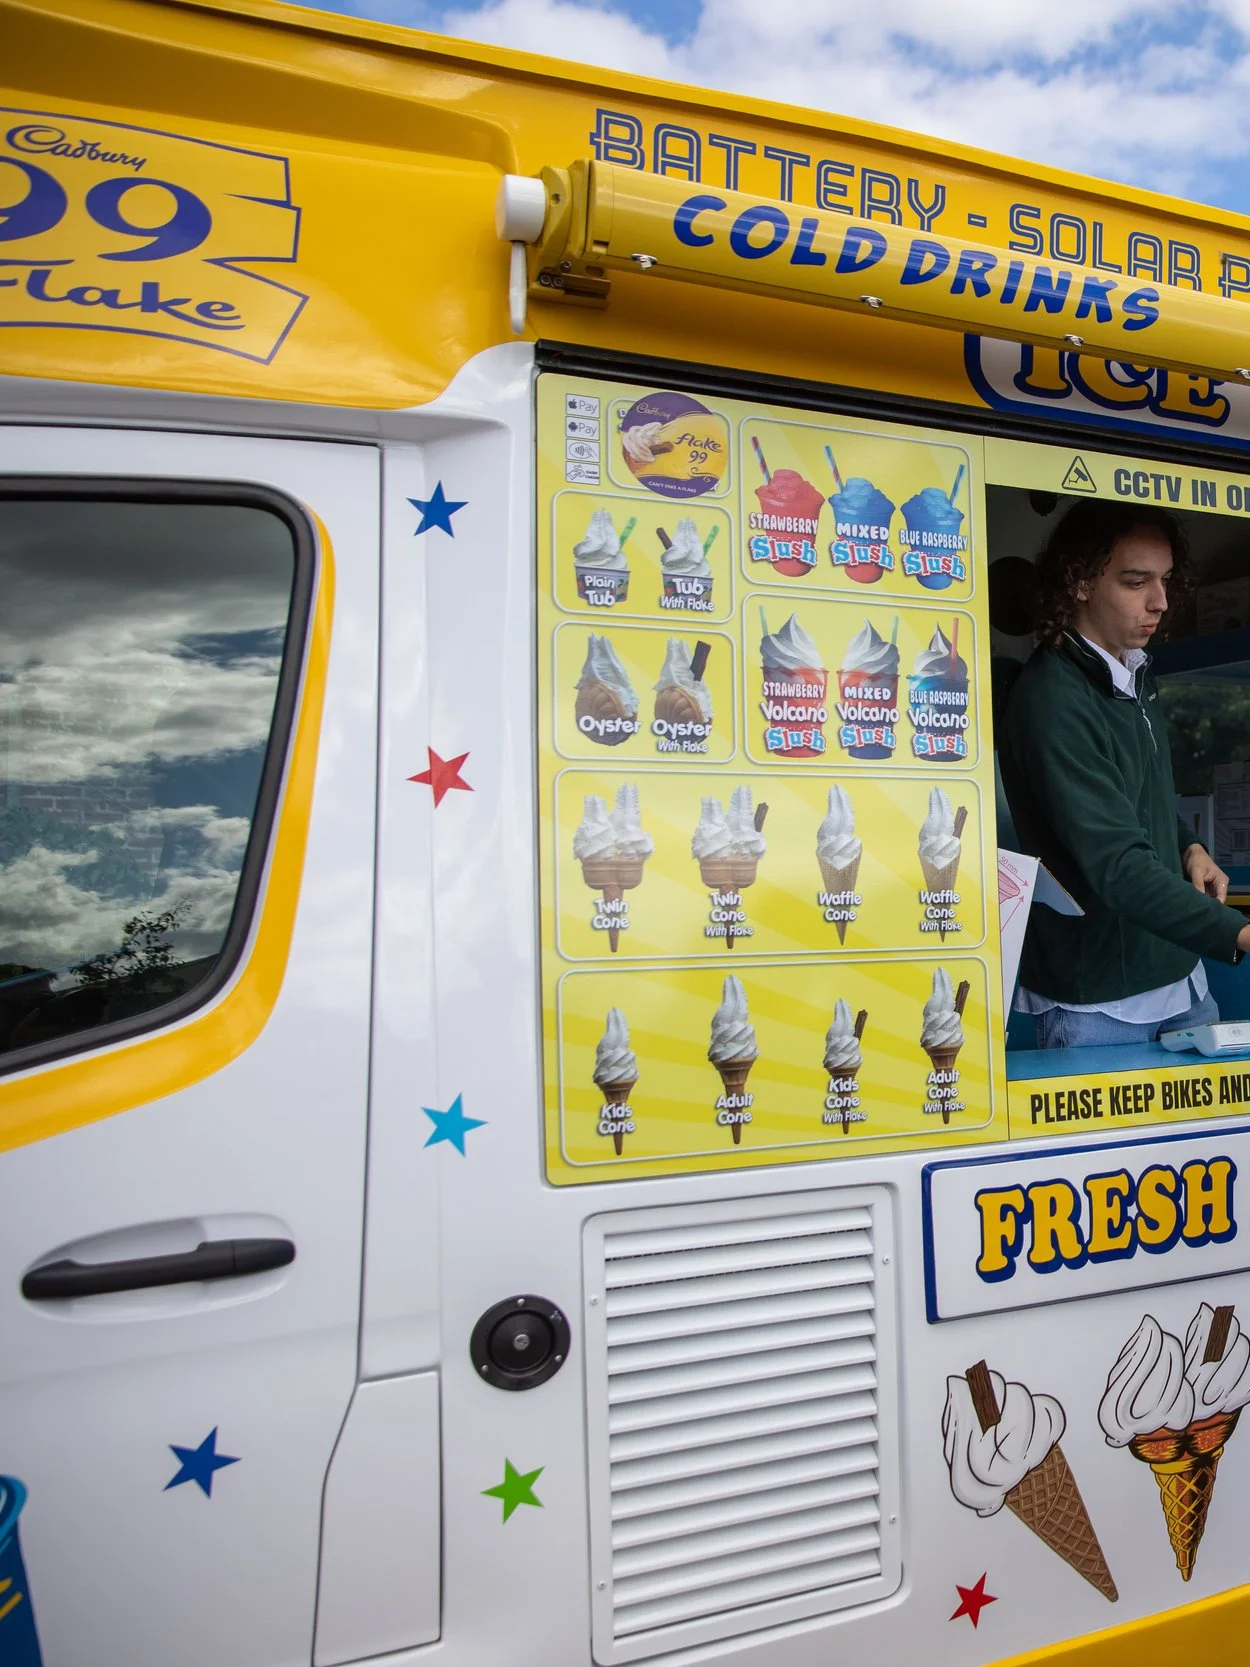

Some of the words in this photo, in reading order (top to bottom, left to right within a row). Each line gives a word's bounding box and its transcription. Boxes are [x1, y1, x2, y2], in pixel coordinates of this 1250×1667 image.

[5, 124, 147, 172] Cadbury
[589, 108, 946, 232] BATTERY
[1008, 203, 1203, 292] SOLAR
[673, 194, 888, 274] COLD
[900, 238, 1161, 332] DRINKS
[1013, 342, 1231, 428] ICE
[579, 400, 598, 415] Pay
[636, 402, 672, 420] Cadbury
[578, 422, 598, 438] Pay
[675, 433, 723, 453] flake
[688, 450, 708, 463] 99
[1114, 468, 1182, 503] CCTV
[1191, 478, 1217, 508] IN
[750, 512, 818, 535] STRAWBERRY
[836, 522, 890, 541] MIXED
[899, 529, 920, 546] BLUE
[921, 531, 968, 550] RASPBERRY
[751, 535, 818, 566] Slush
[831, 539, 895, 571] Slush
[902, 550, 967, 581] Slush
[584, 574, 615, 588] Plain
[672, 578, 704, 596] Tub
[585, 590, 616, 607] Tub
[660, 595, 684, 609] With
[687, 598, 714, 611] Flake
[763, 681, 825, 700] STRAWBERRY
[844, 687, 892, 700] MIXED
[910, 690, 928, 705] BLUE
[929, 690, 969, 707] RASPBERRY
[759, 700, 829, 724] Volcano
[837, 701, 900, 723] Volcano
[908, 708, 970, 730] Volcano
[578, 715, 642, 736] Oyster
[652, 718, 713, 740] Oyster
[657, 740, 681, 752] With
[683, 740, 709, 753] Flake
[765, 726, 827, 752] Slush
[839, 726, 897, 752] Slush
[912, 732, 968, 757] Slush
[710, 891, 743, 906] Twin
[818, 890, 863, 905] Waffle
[920, 889, 961, 904] Waffle
[594, 898, 629, 913] Twin
[824, 907, 857, 921] Cone
[926, 906, 956, 919] Cone
[592, 915, 631, 930] Cone
[710, 908, 746, 923] Cone
[705, 924, 728, 937] With
[729, 924, 754, 936] Flake
[920, 920, 940, 932] With
[941, 920, 963, 931] Flake
[828, 1077, 860, 1093] Kids
[927, 1069, 961, 1084] Adult
[716, 1092, 754, 1109] Adult
[928, 1086, 959, 1099] Cone
[1030, 1082, 1103, 1125] PLEASE
[1109, 1077, 1157, 1116] KEEP
[1162, 1074, 1214, 1111] BIKES
[825, 1095, 861, 1109] Cone
[923, 1102, 943, 1113] With
[944, 1101, 966, 1111] Flake
[600, 1103, 633, 1119] Kids
[717, 1110, 753, 1125] Cone
[822, 1111, 843, 1124] With
[844, 1110, 868, 1122] Flake
[597, 1119, 636, 1135] Cone
[974, 1155, 1237, 1284] FRESH
